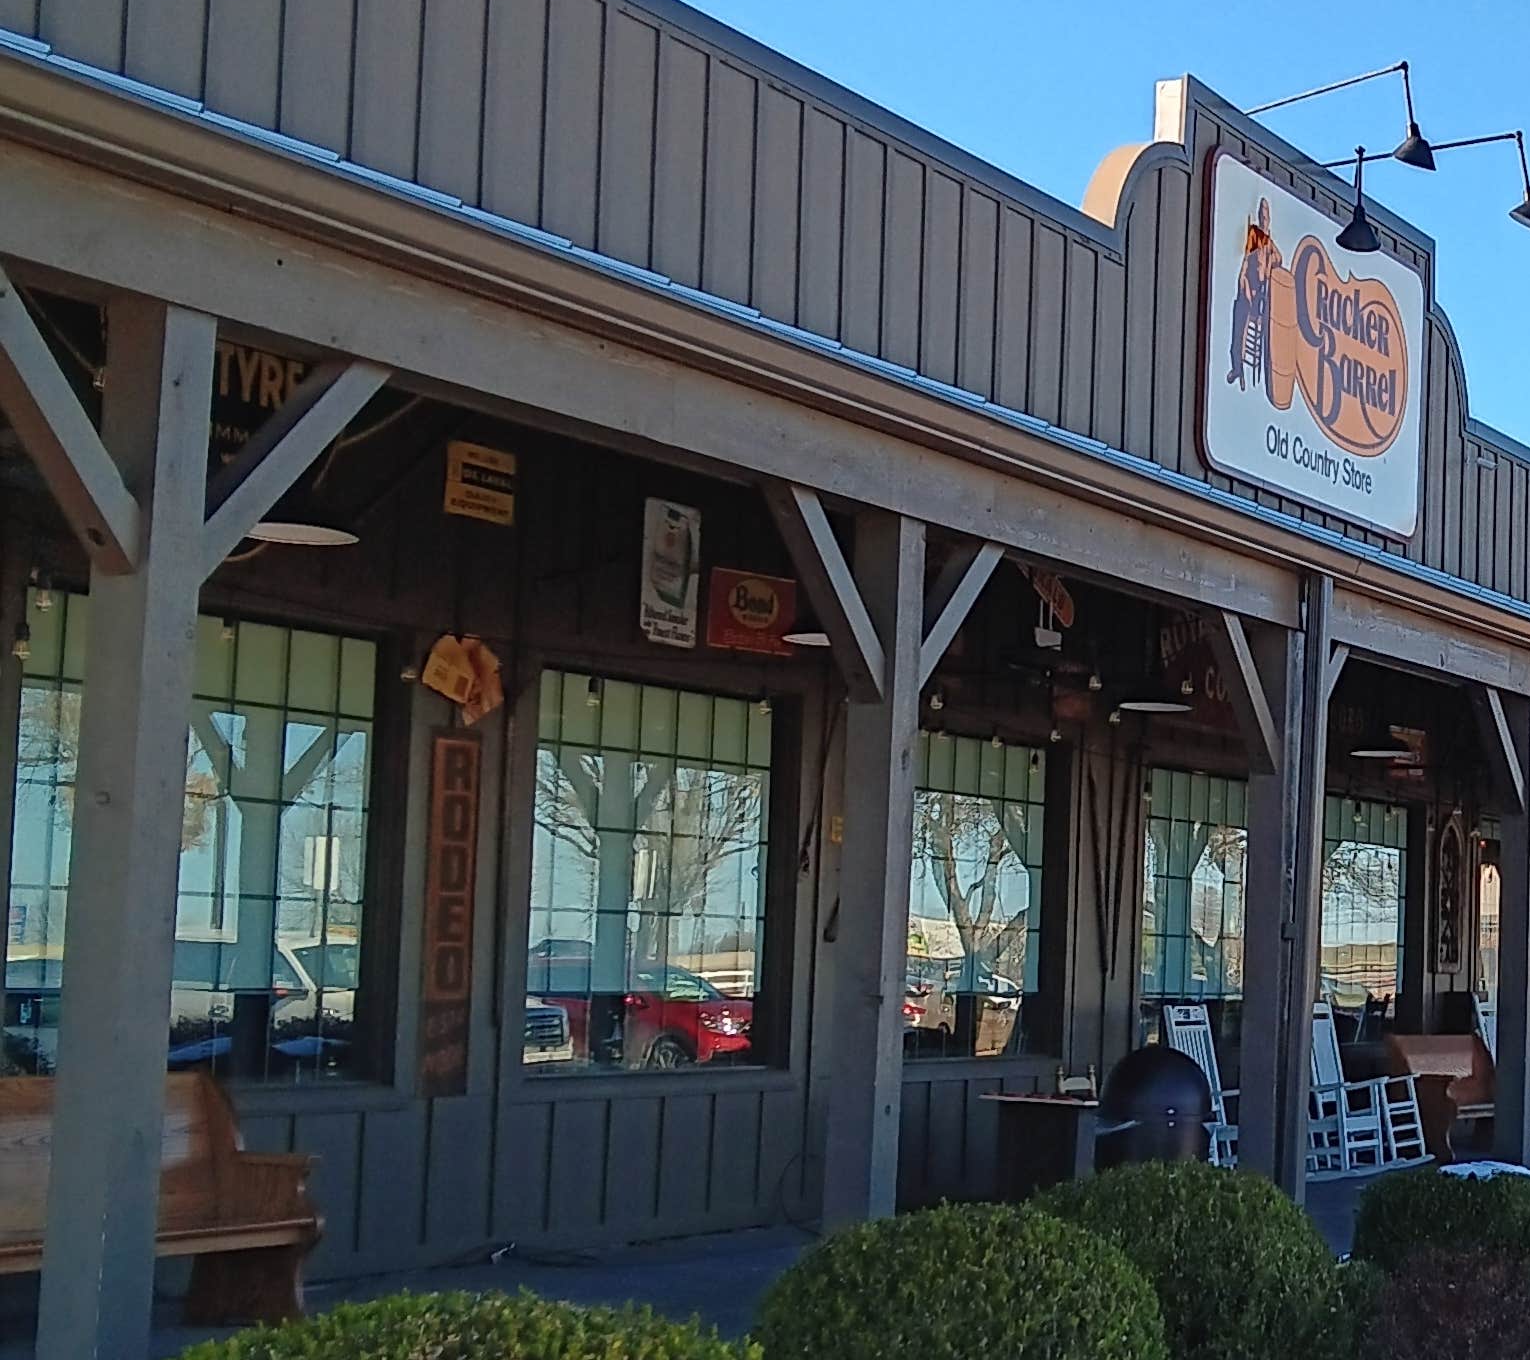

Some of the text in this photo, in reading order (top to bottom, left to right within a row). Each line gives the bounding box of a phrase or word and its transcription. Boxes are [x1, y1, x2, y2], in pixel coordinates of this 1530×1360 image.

[1295, 245, 1391, 358] Cracker
[1316, 322, 1397, 428] Barrel
[1266, 424, 1373, 495] Old Country Store
